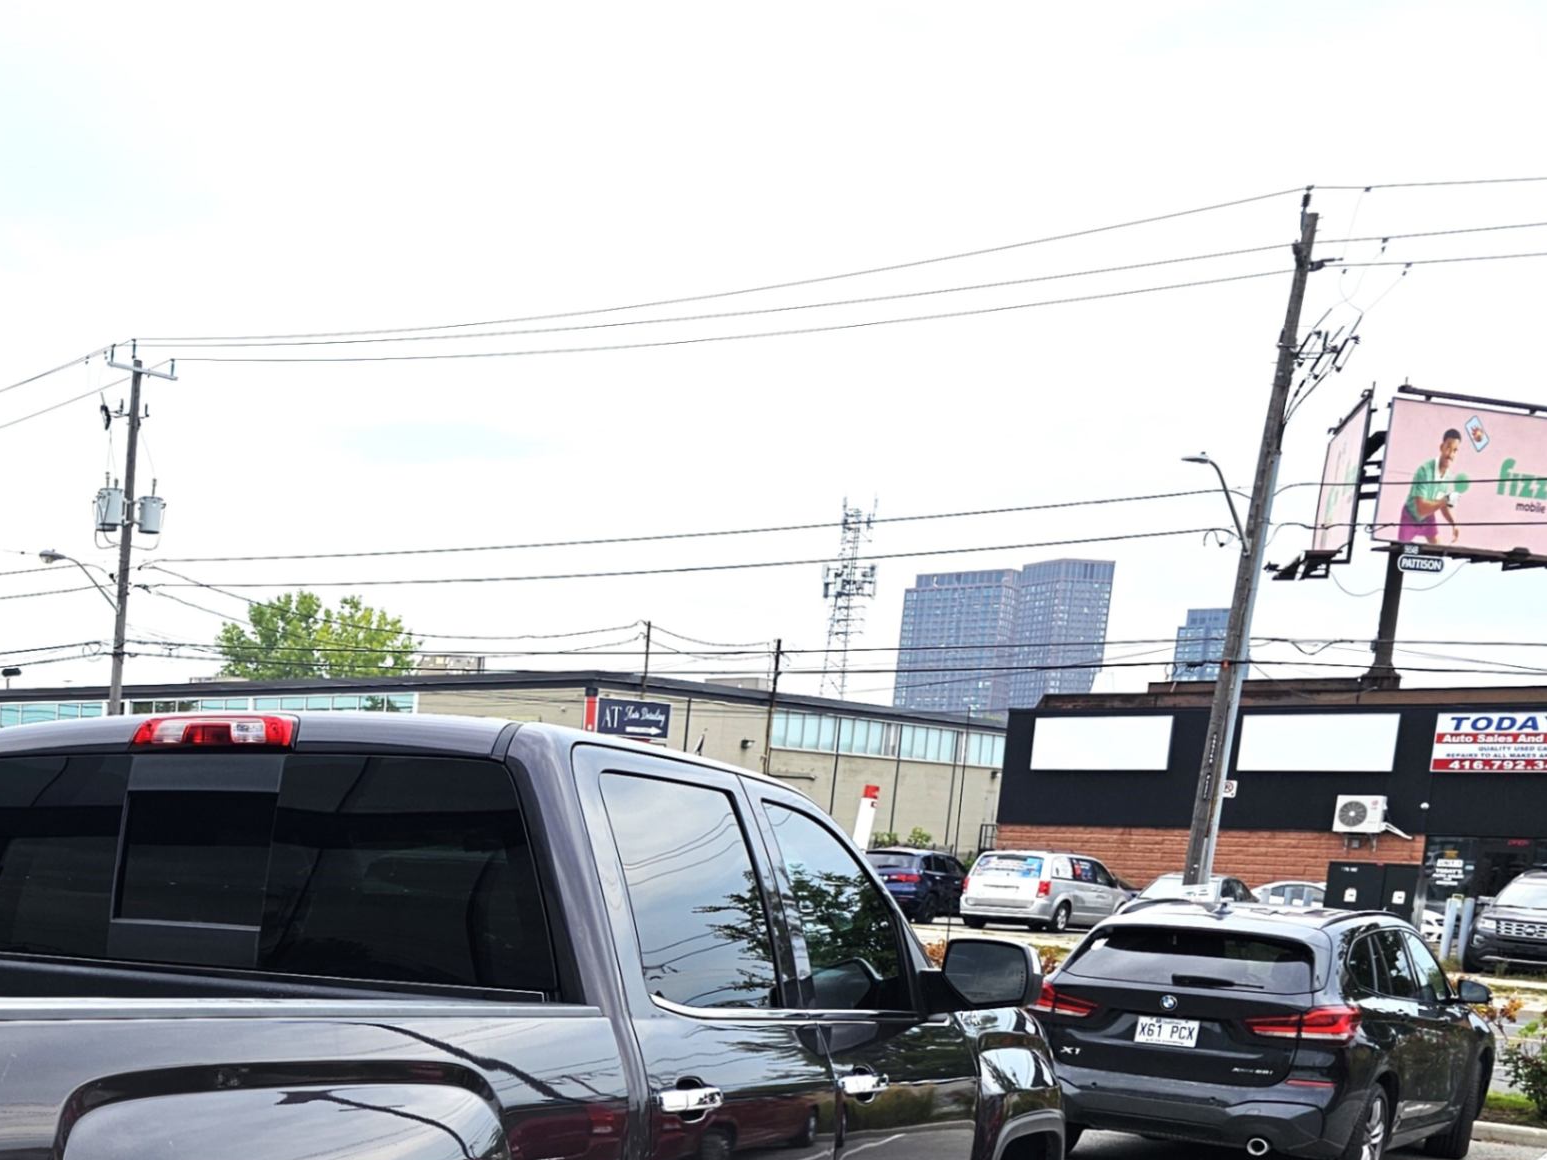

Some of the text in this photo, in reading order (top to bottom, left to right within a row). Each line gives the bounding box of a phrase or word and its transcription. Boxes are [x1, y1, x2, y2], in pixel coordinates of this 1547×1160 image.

[1496, 457, 1547, 500] fizz
[1515, 501, 1546, 514] mobile
[1401, 557, 1442, 571] PATTISON
[601, 705, 623, 728] AT
[1451, 716, 1547, 731] TODA
[1442, 734, 1545, 743] Auto Sales And
[1140, 1022, 1195, 1041] X61 PCX
